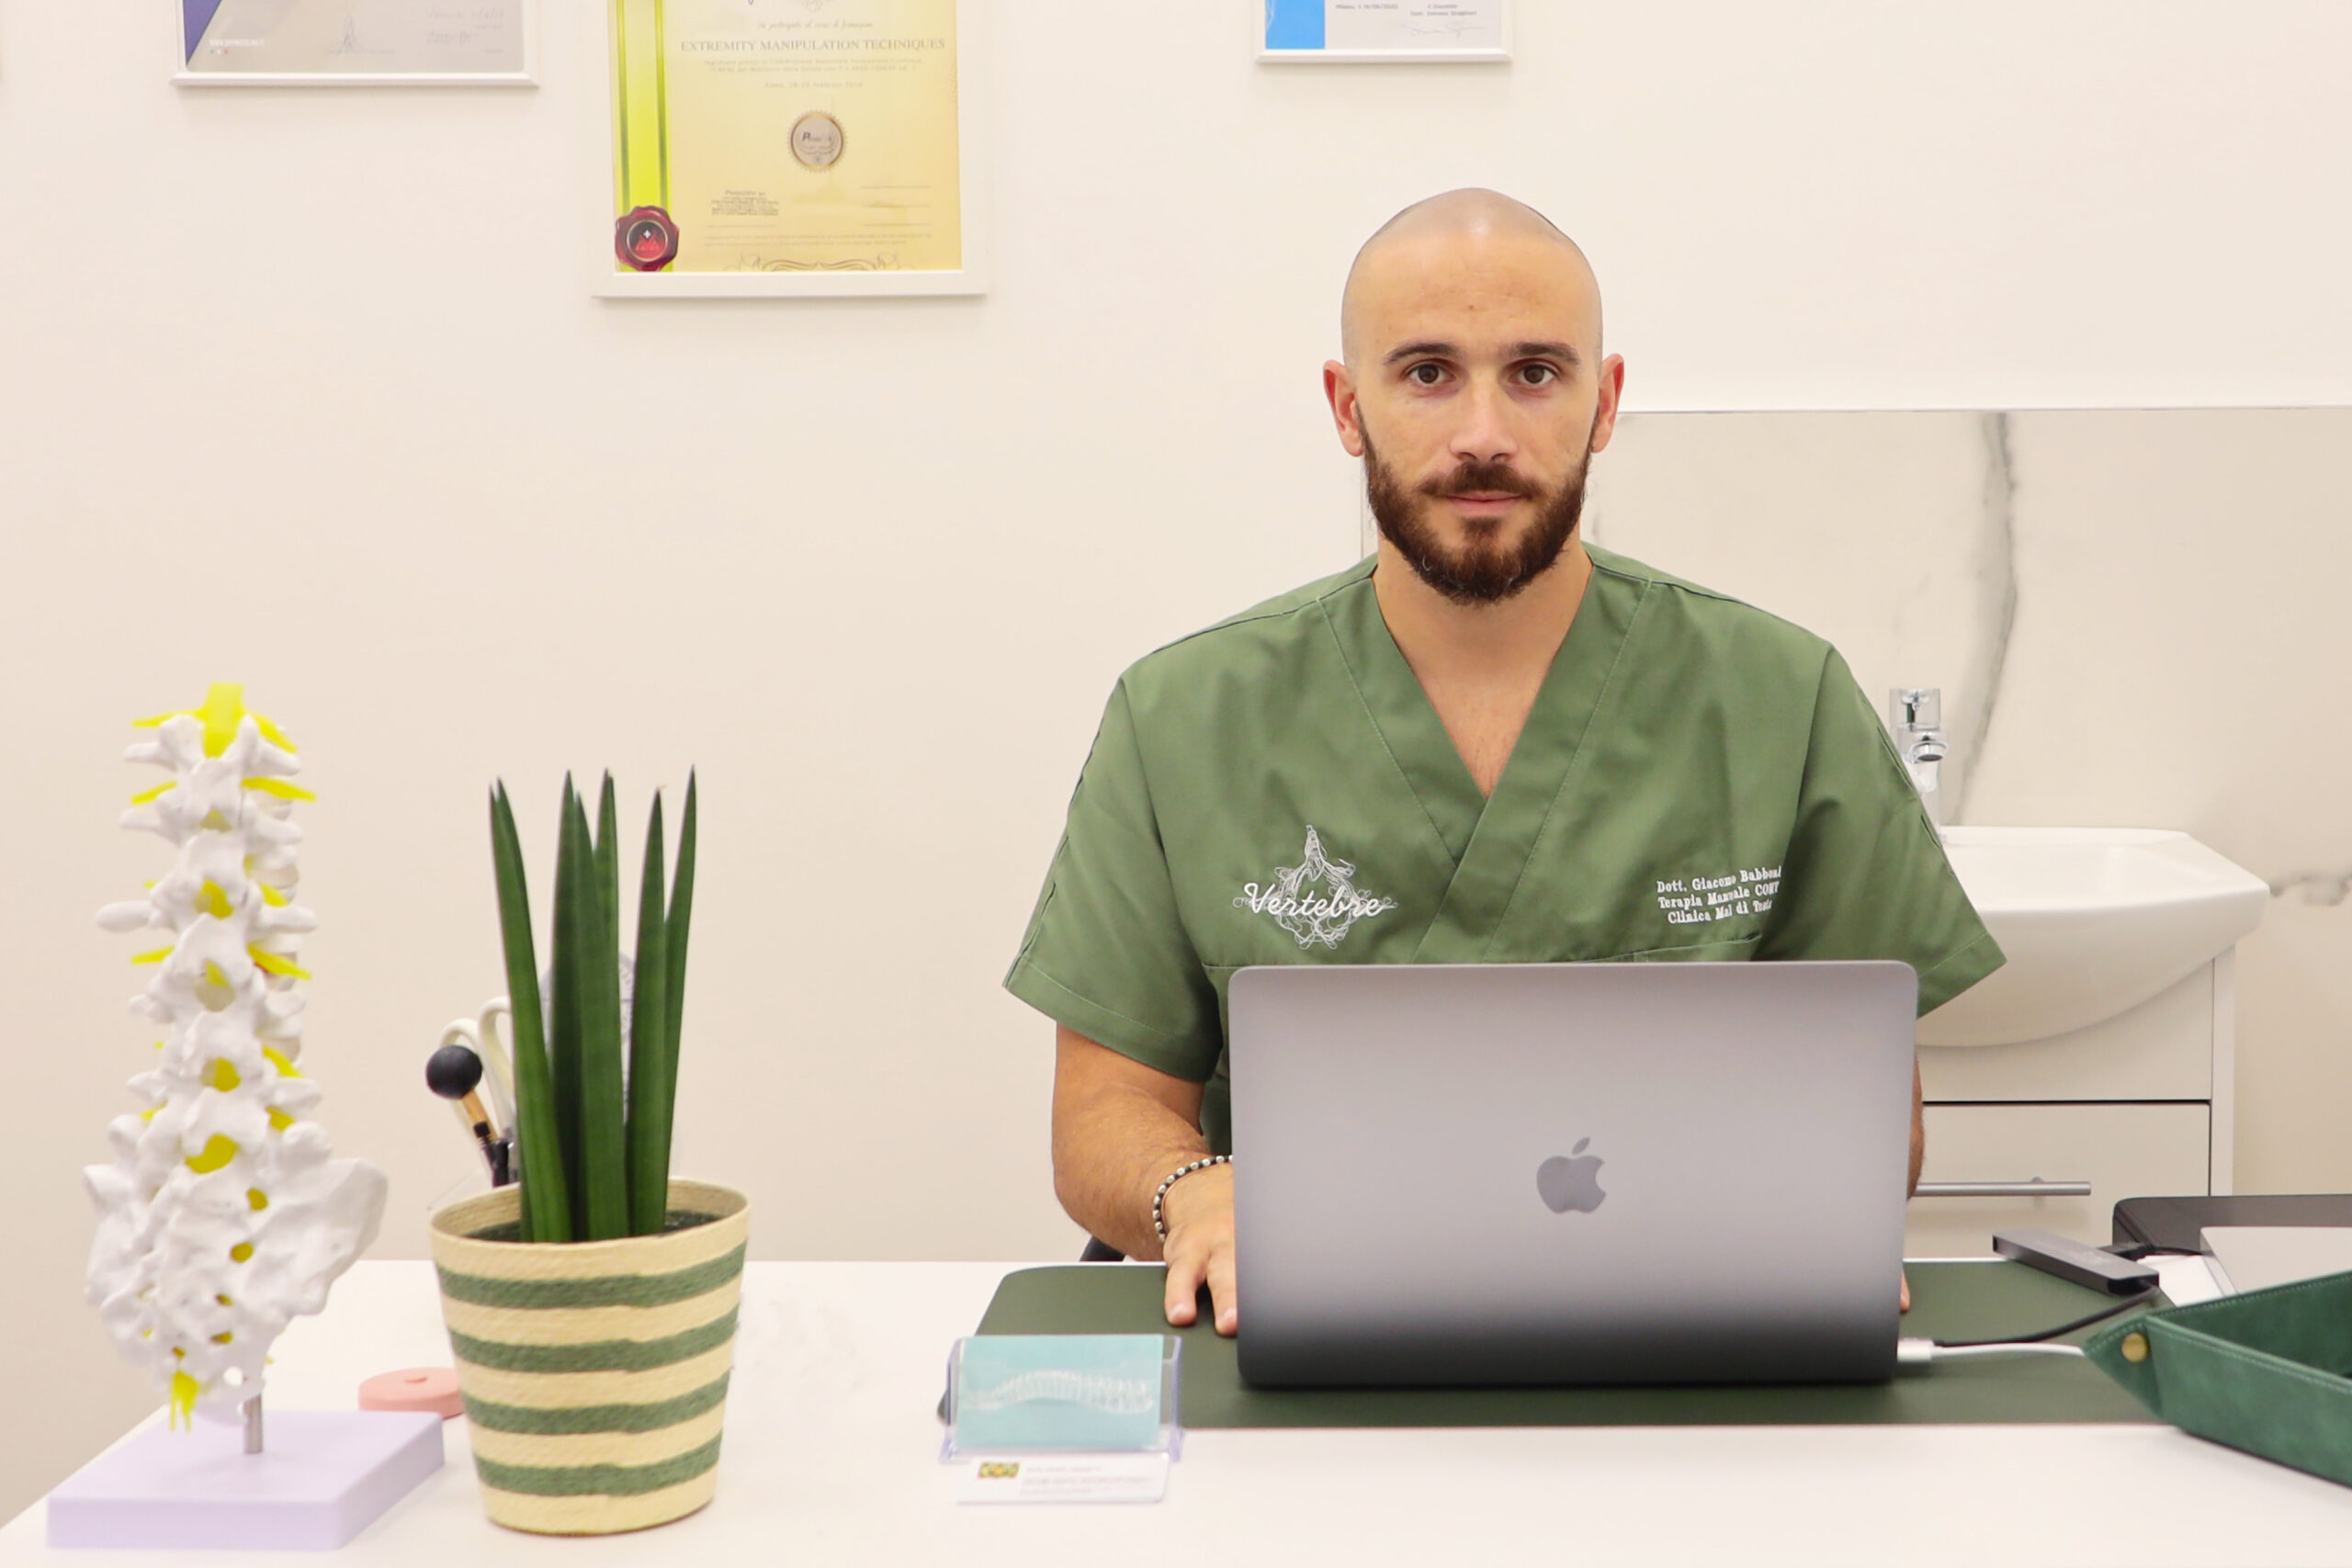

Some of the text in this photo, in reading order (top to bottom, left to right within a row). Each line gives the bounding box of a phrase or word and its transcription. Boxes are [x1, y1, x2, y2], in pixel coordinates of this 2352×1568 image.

[681, 39, 945, 51] EXTREMITY MANIPULATION TECHNIQUES
[1657, 880, 1688, 894] Dott.
[1691, 874, 1736, 891] Giacomo
[1244, 883, 1390, 918] Vertebre
[1657, 894, 1703, 910] Terapia
[1707, 886, 1751, 906] Manuale
[1668, 908, 1712, 924] Clinica
[1714, 903, 1734, 920] Mal
[1736, 901, 1749, 915] di
